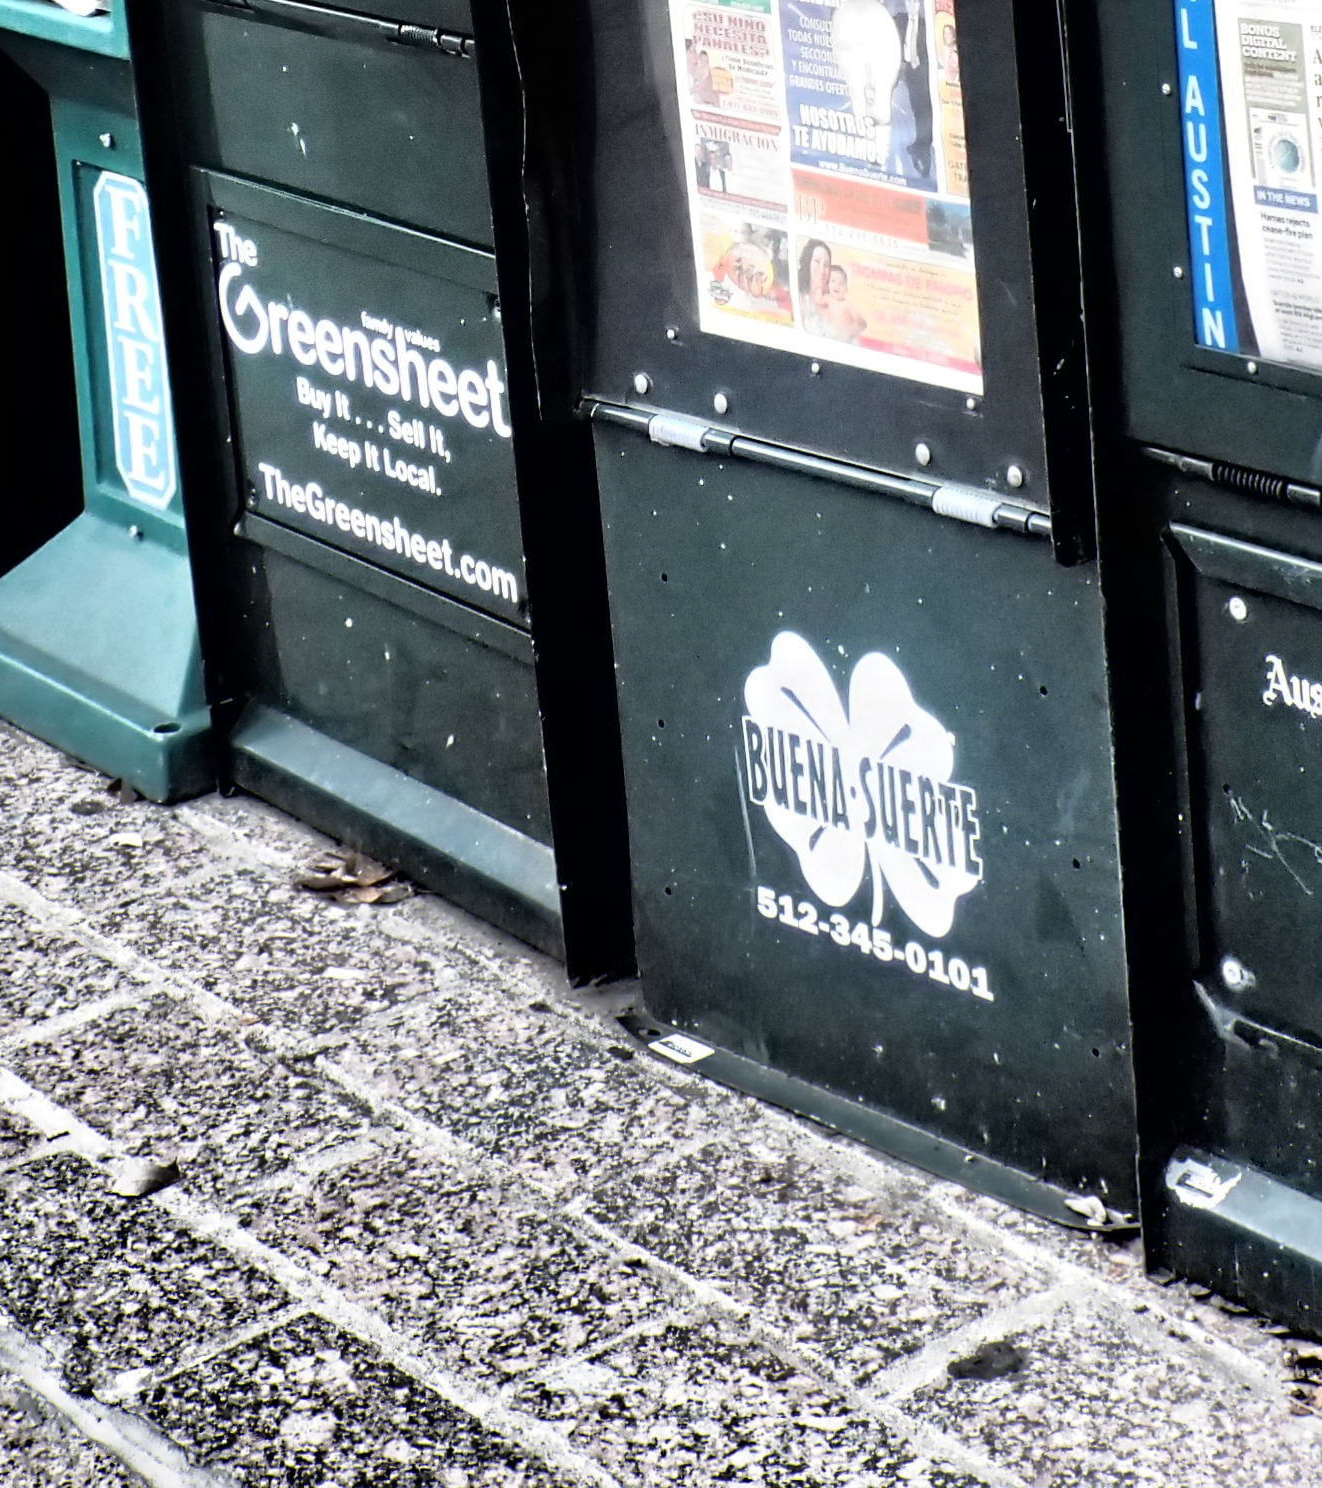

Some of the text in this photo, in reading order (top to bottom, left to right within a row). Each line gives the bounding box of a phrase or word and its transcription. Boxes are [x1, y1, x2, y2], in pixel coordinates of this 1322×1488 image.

[799, 14, 834, 32] CONSULT
[1240, 23, 1281, 38] BONUS
[788, 28, 835, 48] TODAS NUES
[1241, 35, 1287, 50] DIGITAL
[1243, 46, 1298, 63] CONTENT
[788, 74, 825, 92] GRANDES
[800, 104, 876, 139] NOSOTROS
[792, 124, 810, 147] TE
[1256, 190, 1311, 207] IN THE NEWS
[1183, 74, 1226, 349] AUSTIN
[1286, 216, 1311, 228] rejects
[214, 221, 258, 267] The
[1298, 229, 1314, 240] plan
[103, 183, 165, 490] FREE
[218, 262, 512, 438] Greensheet
[296, 376, 452, 464] Buy It Sell It,
[312, 421, 443, 497] Keep It Local.
[258, 462, 518, 604] TheGreensheet.com
[756, 885, 995, 1003] 512-345-0101
